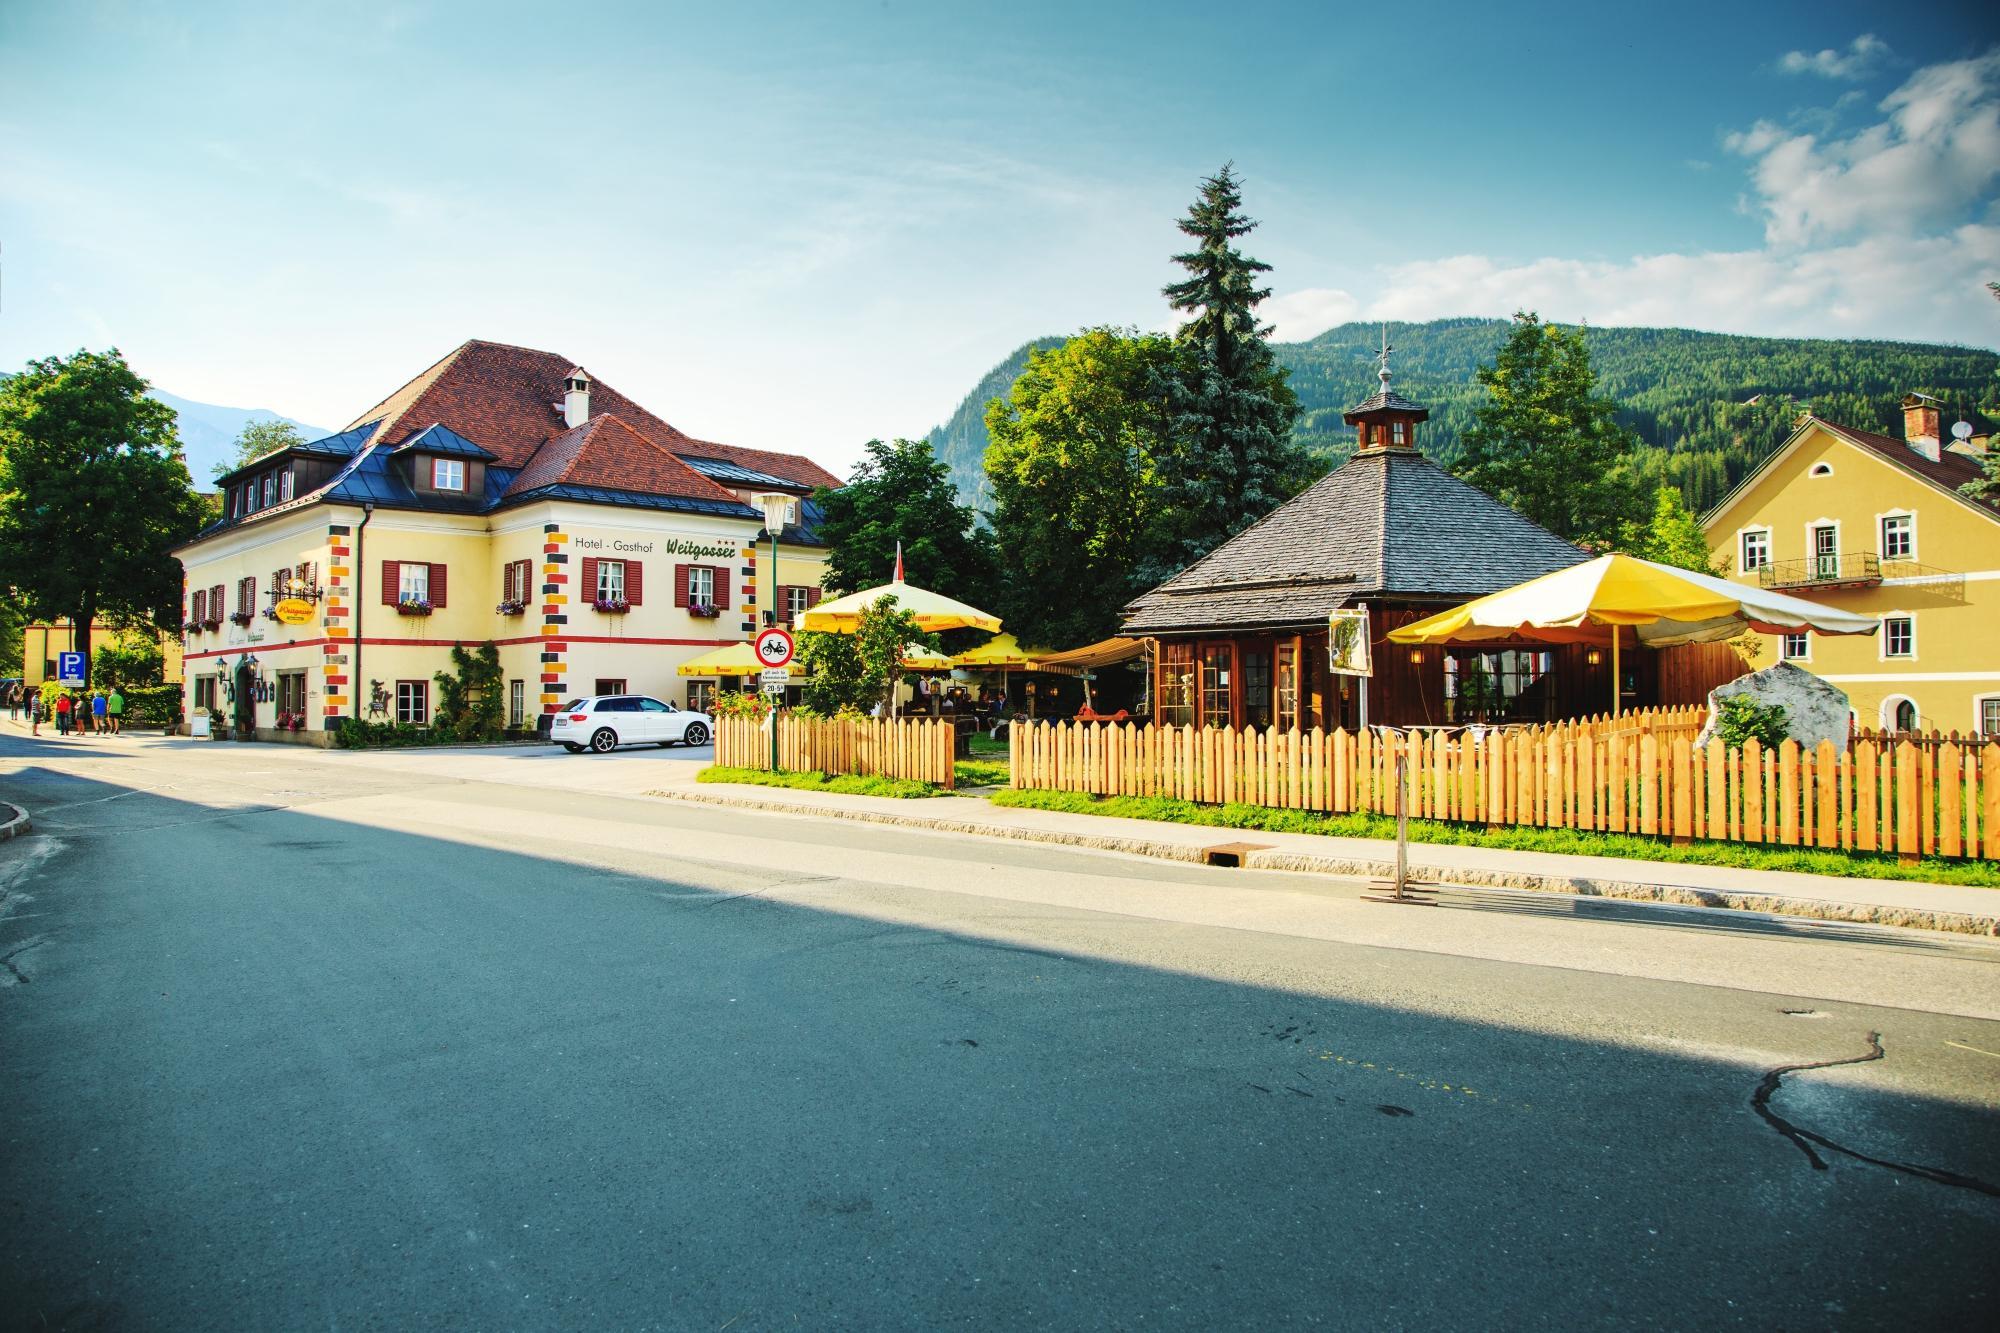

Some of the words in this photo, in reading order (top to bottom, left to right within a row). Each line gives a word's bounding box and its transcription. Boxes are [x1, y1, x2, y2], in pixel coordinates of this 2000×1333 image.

[575, 537, 603, 549] Hotel
[613, 540, 654, 553] Gasthof
[666, 538, 736, 561] Weitgasser
[65, 654, 81, 672] P
